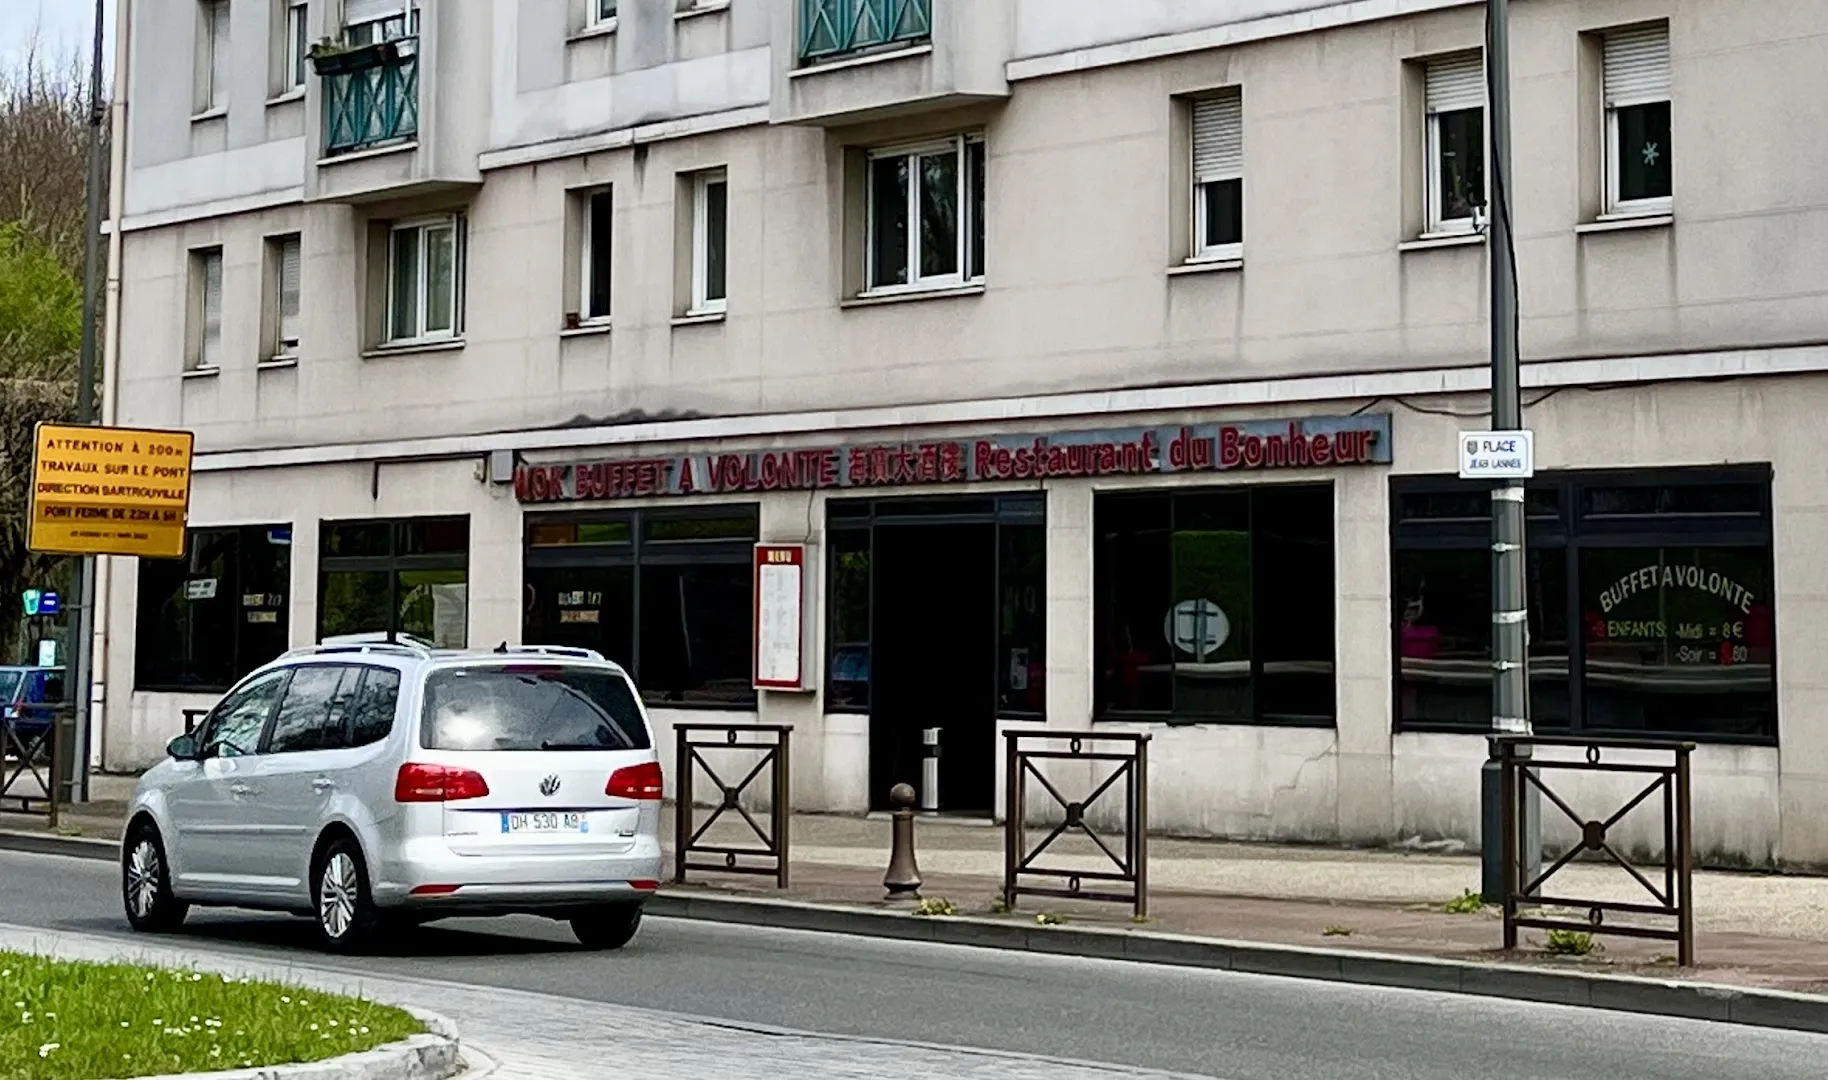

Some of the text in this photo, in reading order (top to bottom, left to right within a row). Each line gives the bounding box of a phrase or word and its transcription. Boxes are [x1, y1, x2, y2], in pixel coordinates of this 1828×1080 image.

[47, 439, 124, 453] ATTENTION
[973, 421, 1377, 480] Restaurant du Bonheur
[1483, 441, 1516, 452] PLACE
[41, 460, 186, 478] TRAVAUX SUR LE PONT
[575, 459, 671, 498] BUFFET
[678, 457, 694, 491] A
[707, 449, 834, 490] VOLONTE
[37, 482, 99, 495] DIRECTION
[44, 505, 73, 518] PONT
[1600, 565, 1755, 615] BUFFET A VOLONTE
[533, 812, 558, 829] 530
